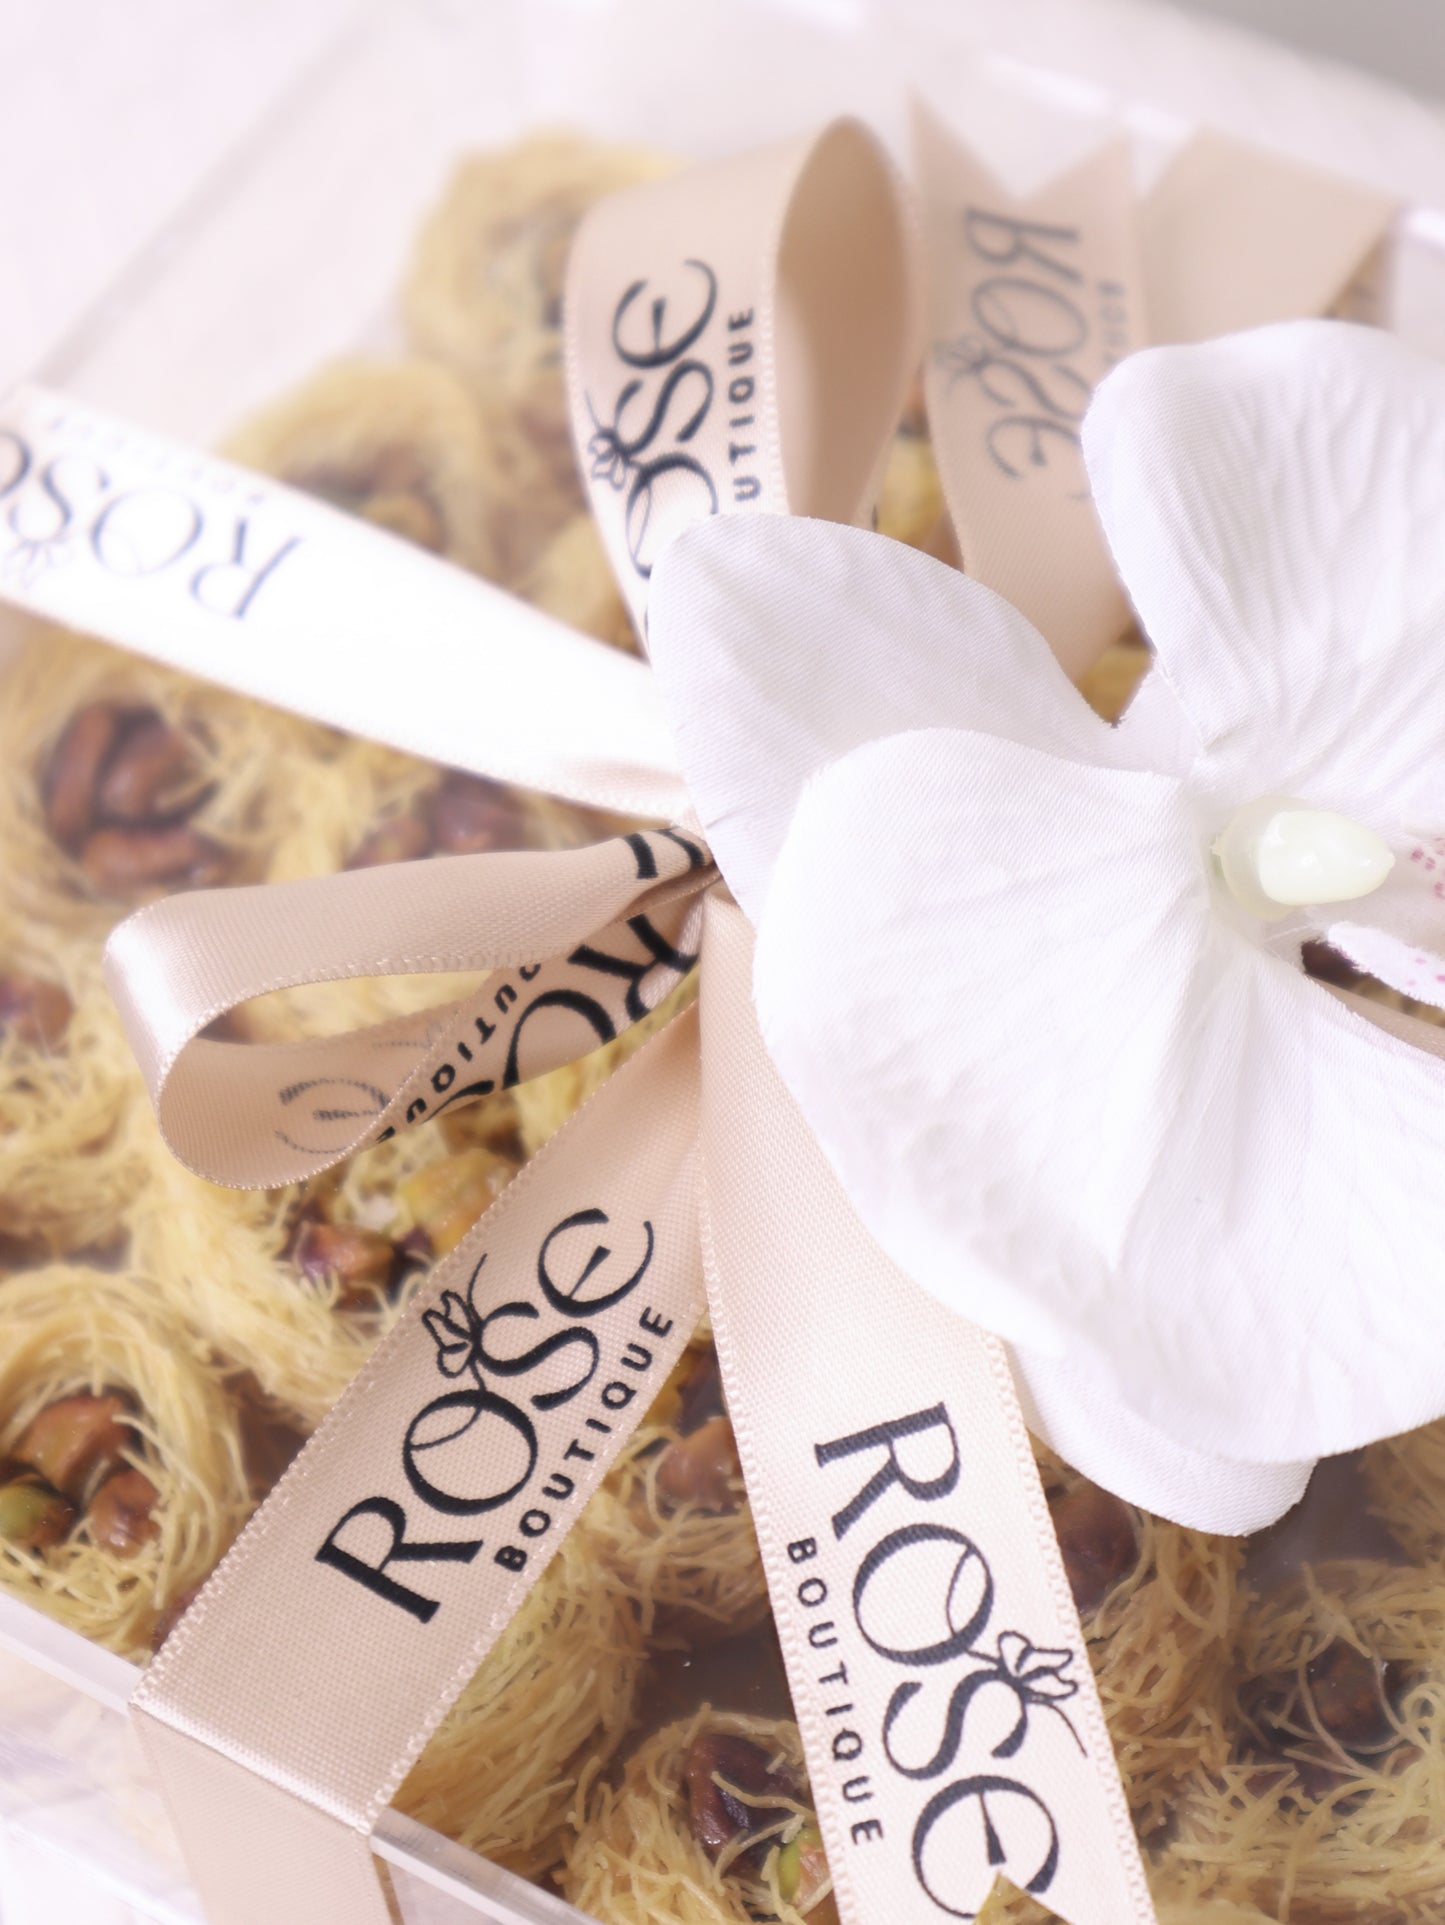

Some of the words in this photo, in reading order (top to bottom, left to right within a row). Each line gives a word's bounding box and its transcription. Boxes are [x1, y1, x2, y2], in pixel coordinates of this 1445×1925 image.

[612, 258, 718, 580] OSE
[727, 307, 761, 501] UTIQUE
[315, 1208, 654, 1623] ROSE
[494, 1306, 674, 1572] BOUTIQUE
[786, 1537, 884, 1846] BOUTIQUE
[813, 1401, 1060, 1919] ROSE
